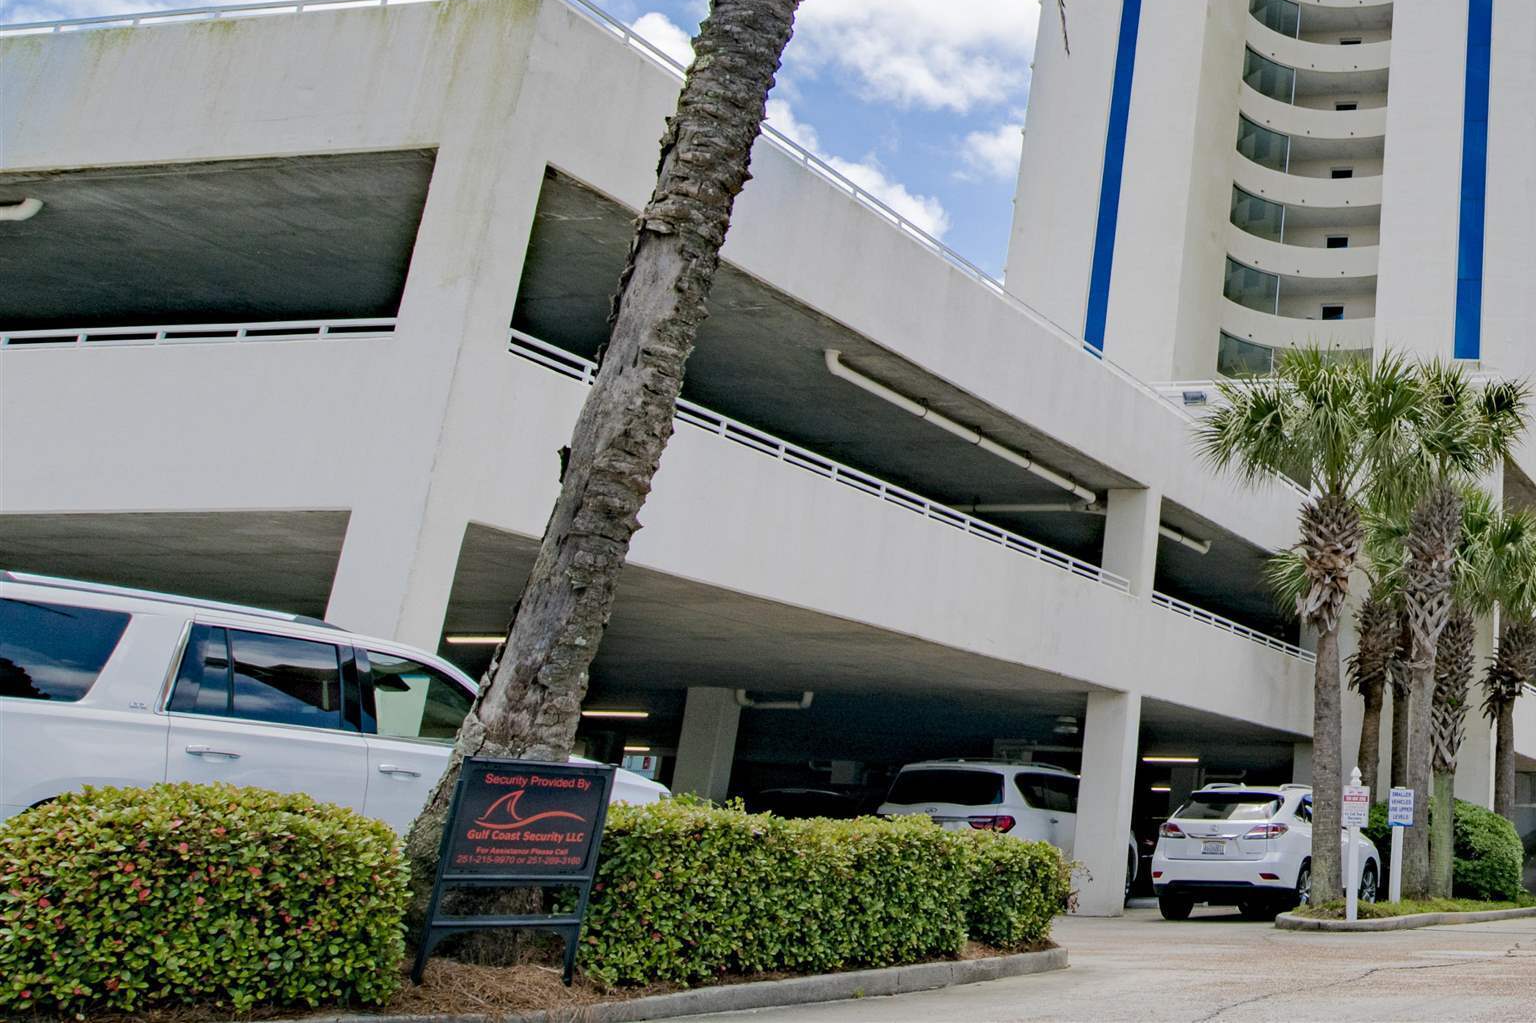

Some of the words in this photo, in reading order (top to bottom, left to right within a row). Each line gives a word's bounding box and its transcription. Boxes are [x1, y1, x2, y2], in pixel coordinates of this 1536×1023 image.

[485, 773, 528, 787] Security
[530, 776, 575, 788] Provided
[577, 778, 591, 791] By
[466, 829, 490, 840] Gulf
[492, 830, 521, 841] Coast
[522, 831, 564, 843] Security
[565, 832, 585, 842] LLC
